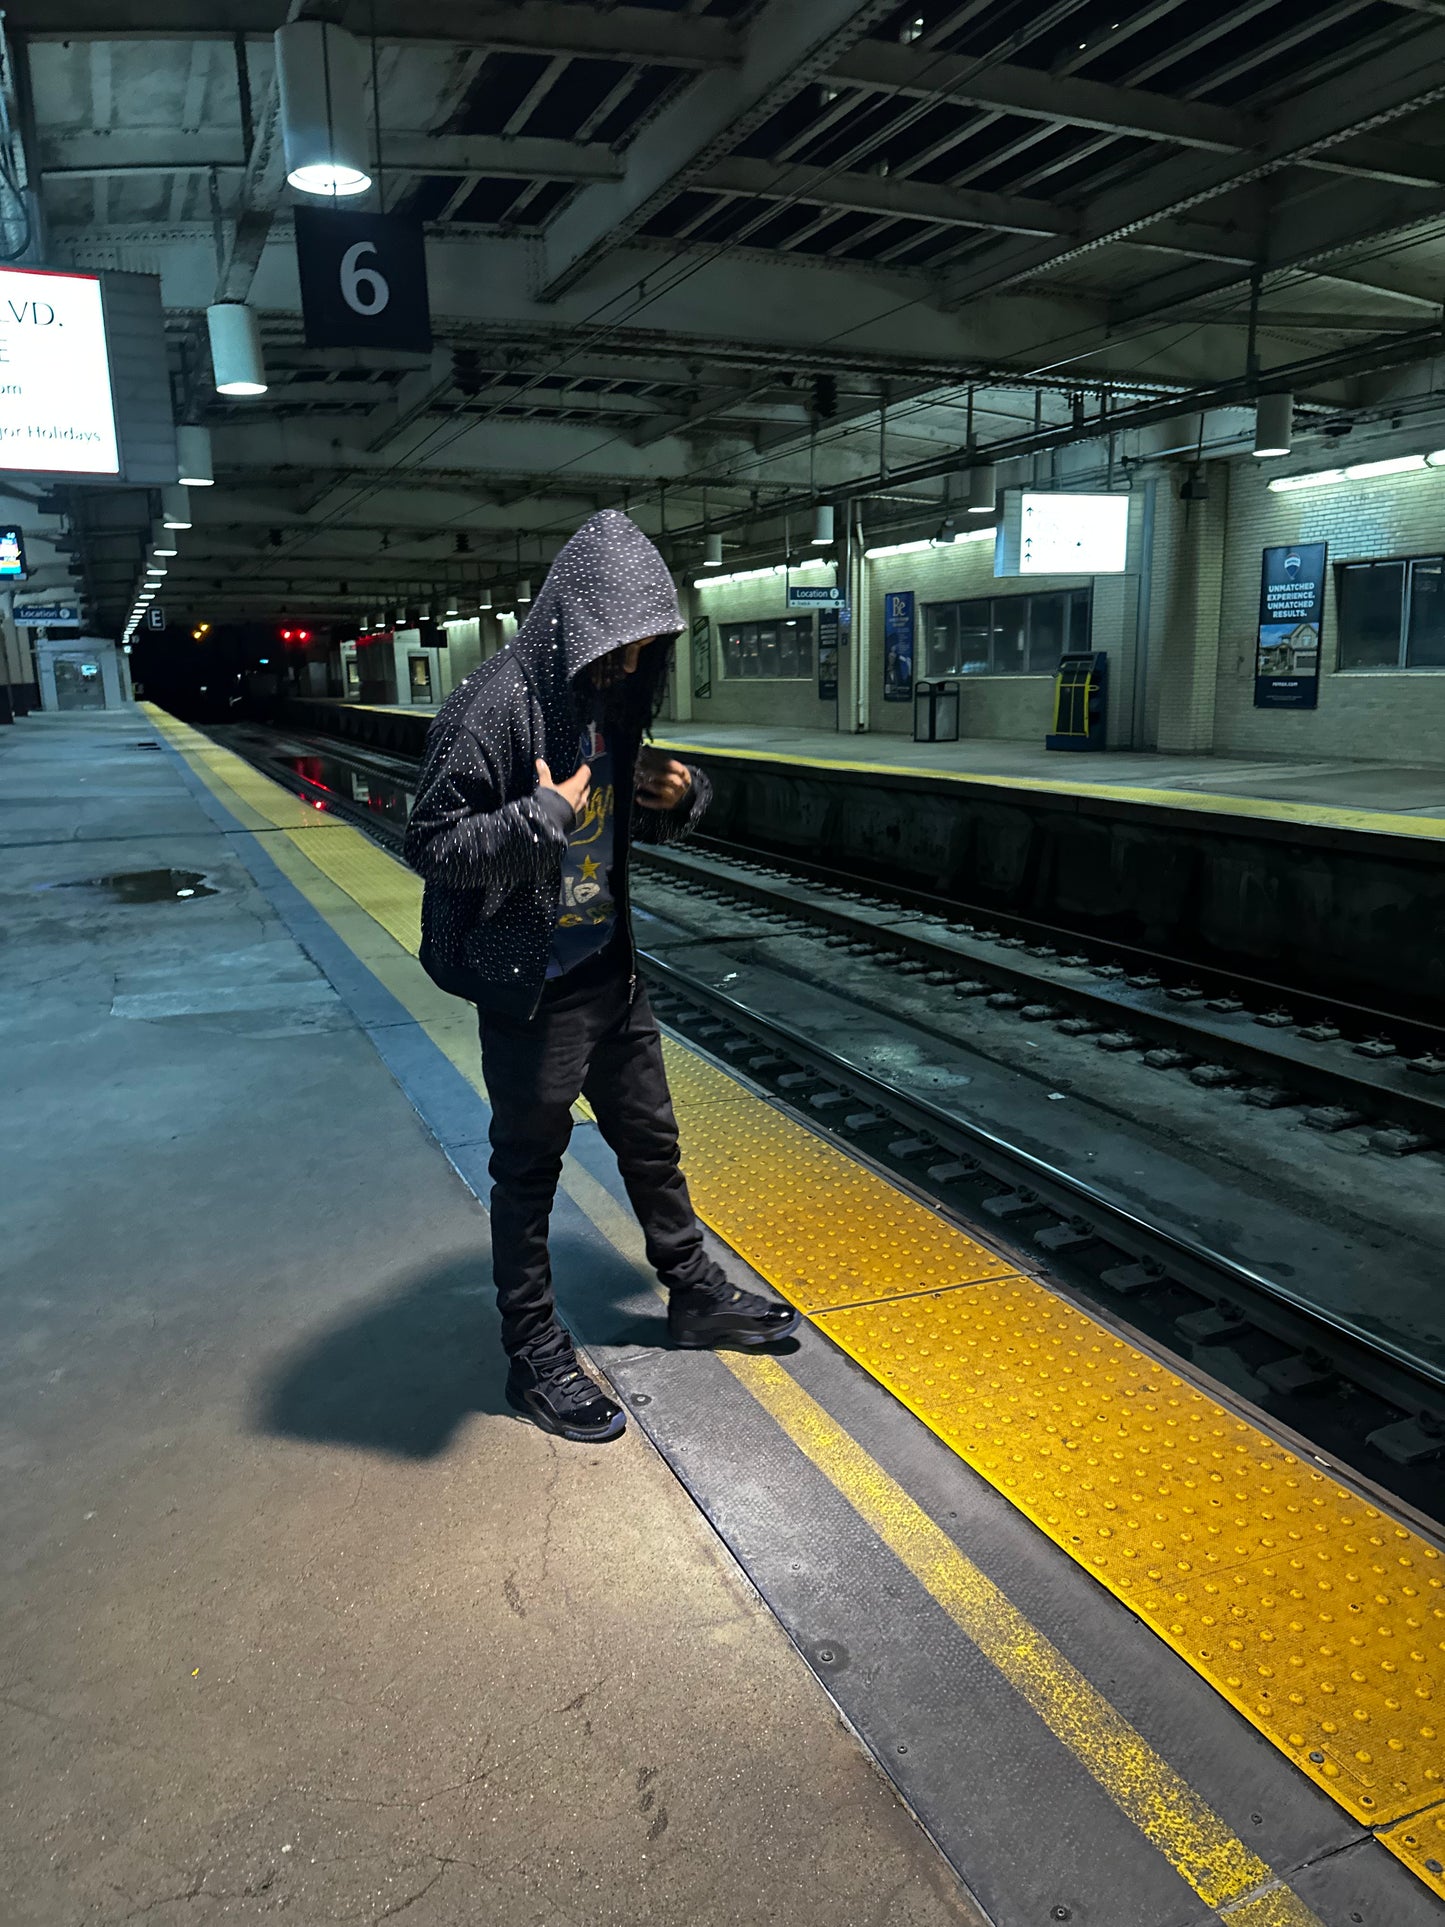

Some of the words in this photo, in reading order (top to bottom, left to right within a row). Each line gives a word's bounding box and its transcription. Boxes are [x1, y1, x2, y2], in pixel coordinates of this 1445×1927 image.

[340, 241, 390, 316] 6
[27, 425, 102, 445] Holidays
[1268, 582, 1315, 593] UNMATCHED
[796, 589, 829, 599] Location
[1266, 591, 1316, 602] EXPERIENCE.
[892, 596, 907, 617] Be
[1267, 600, 1314, 610] UNMATCHED
[19, 610, 58, 619] Location
[150, 609, 162, 627] E
[1272, 609, 1308, 619] RESULTS.
